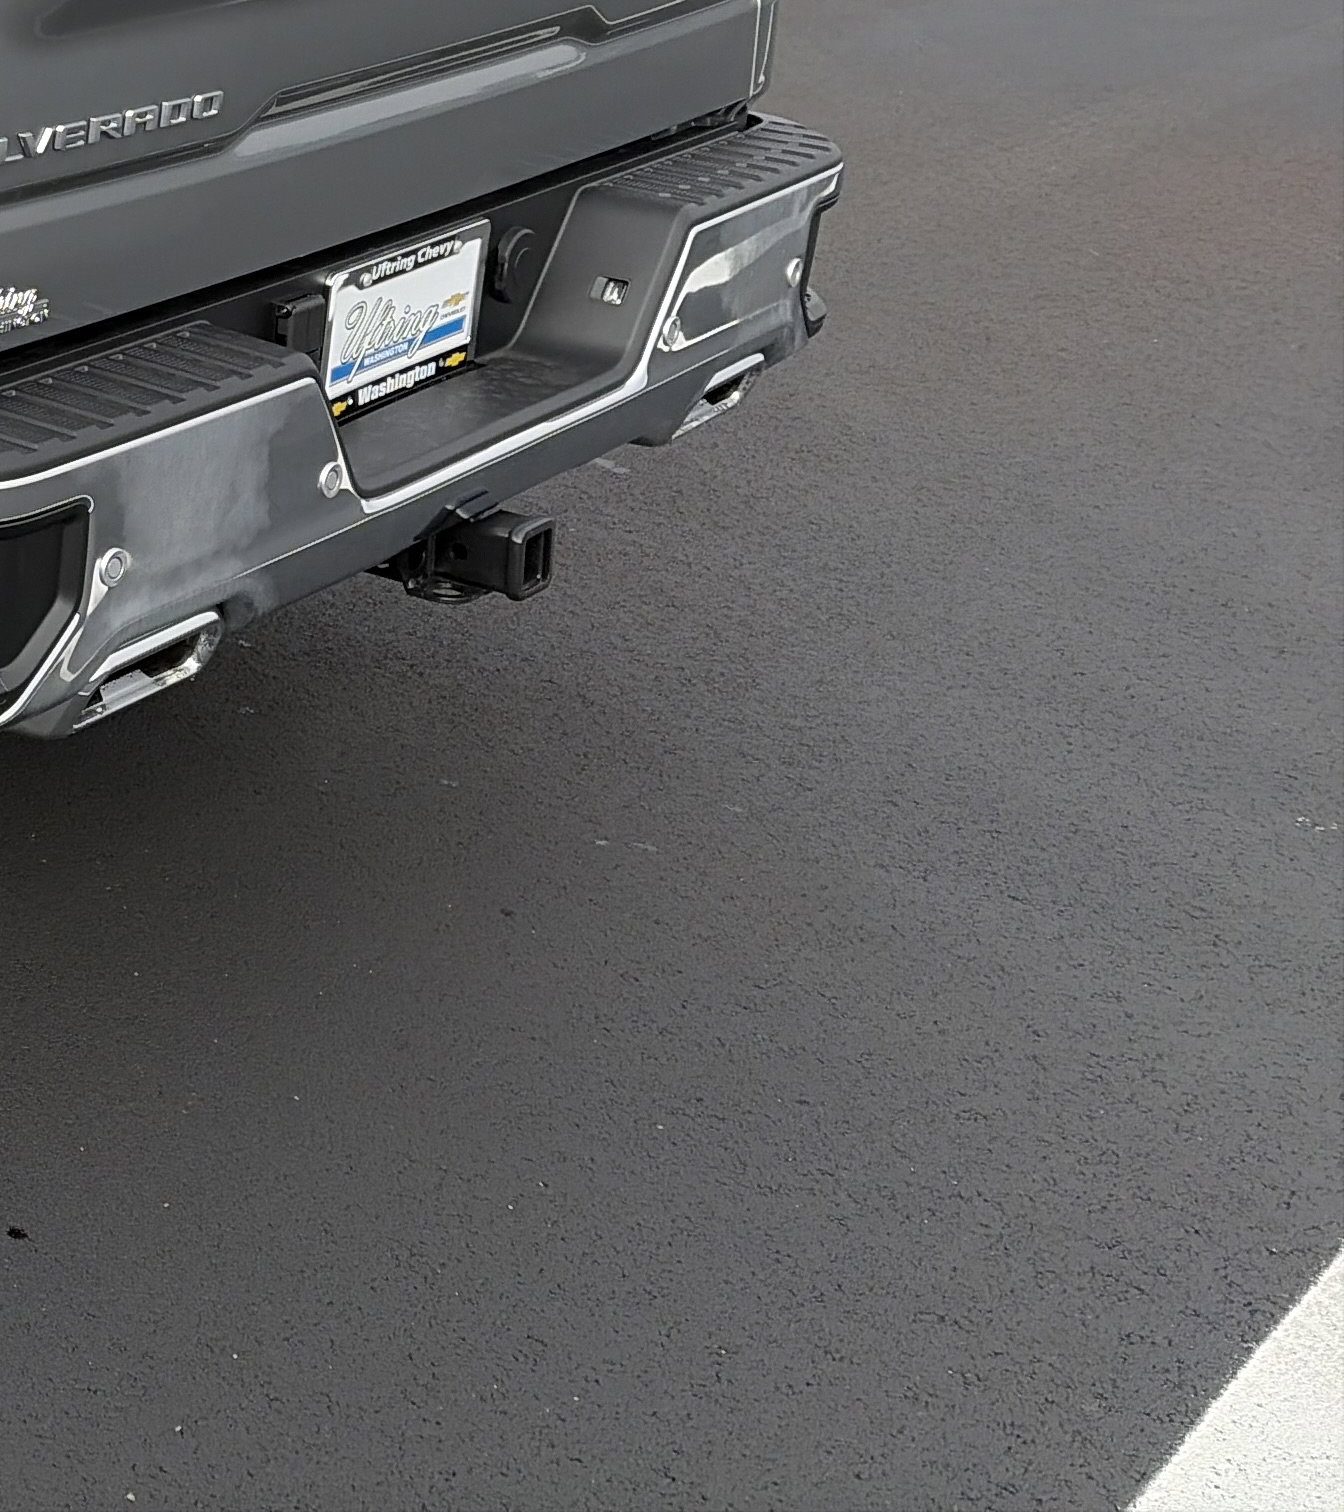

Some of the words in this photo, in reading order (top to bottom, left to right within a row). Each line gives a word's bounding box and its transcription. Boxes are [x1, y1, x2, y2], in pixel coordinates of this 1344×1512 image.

[372, 254, 416, 281] Uftring
[417, 240, 454, 264] Chevy
[340, 296, 439, 384] Uftring
[357, 361, 437, 406] Washington
